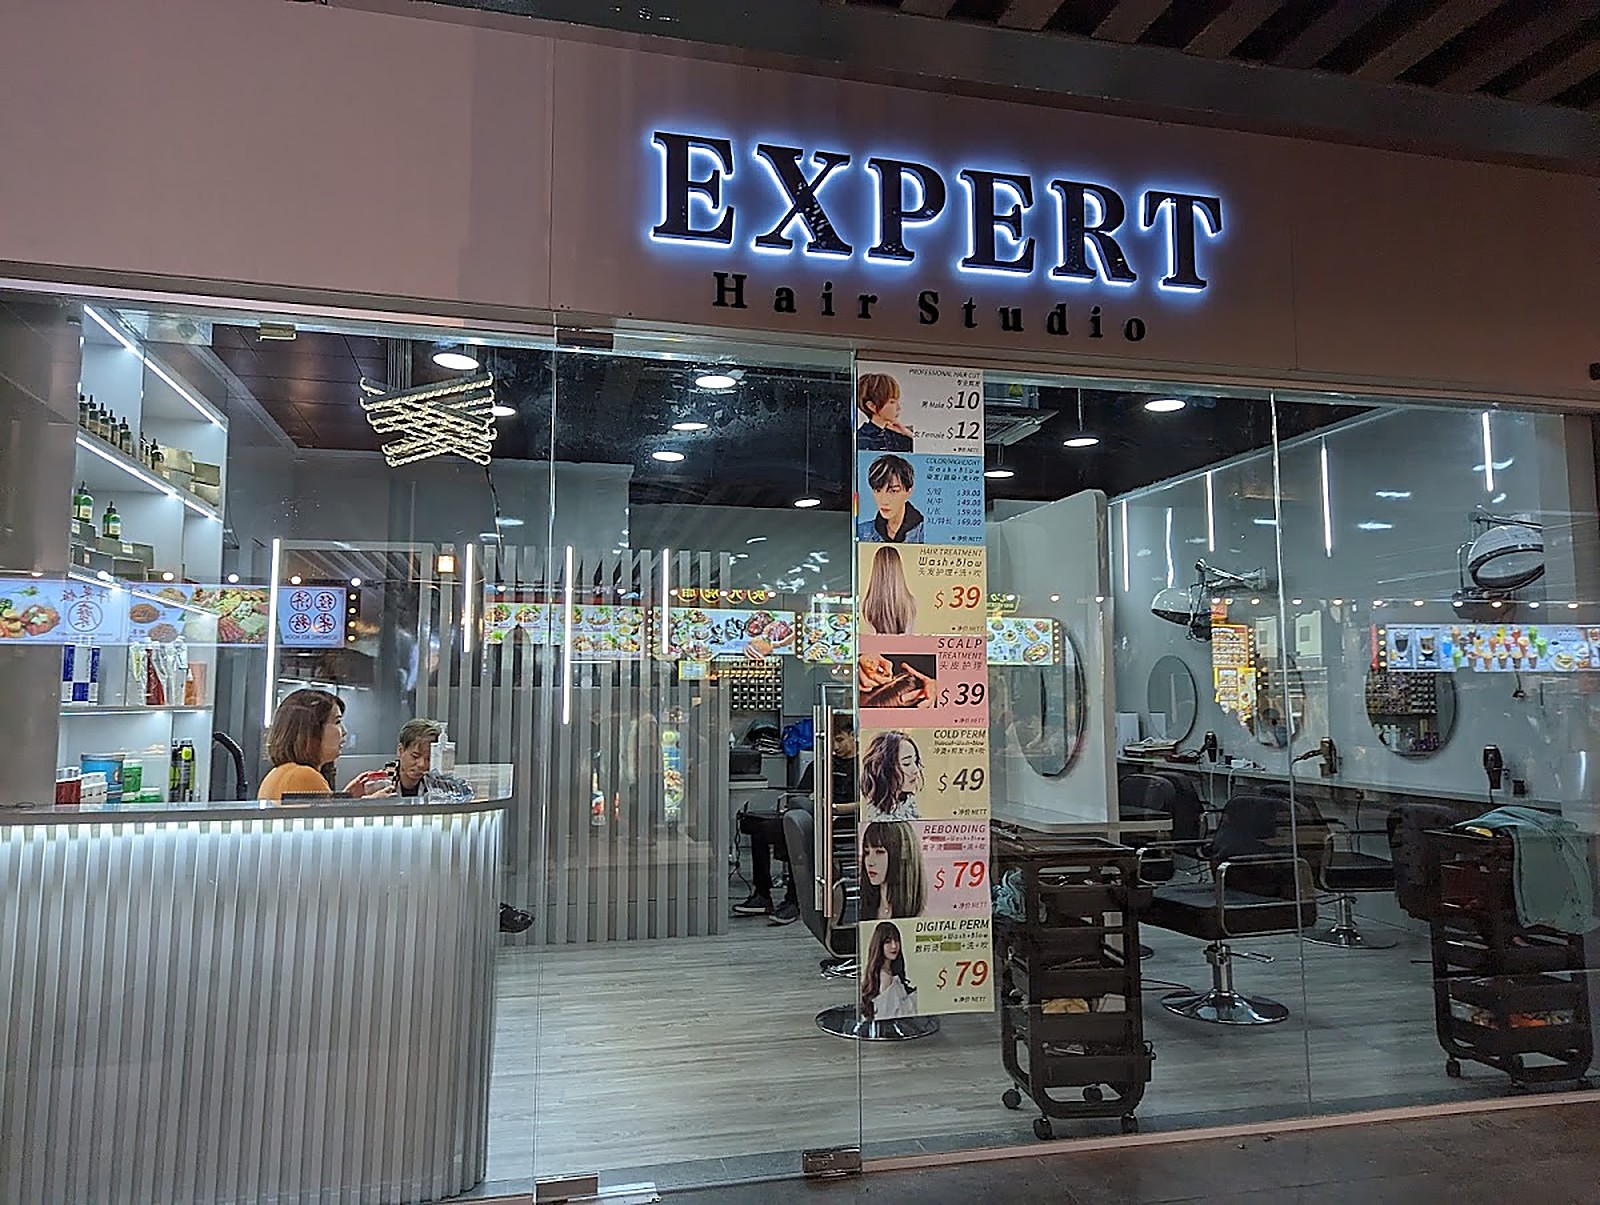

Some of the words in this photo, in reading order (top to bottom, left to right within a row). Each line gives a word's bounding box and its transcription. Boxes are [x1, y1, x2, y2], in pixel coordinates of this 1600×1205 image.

[650, 130, 1222, 291] EXPERT
[712, 271, 878, 320] Hair
[918, 290, 1147, 342] Studio
[921, 431, 945, 439] Female
[920, 548, 938, 556] HAIR
[939, 549, 983, 557] TREATMENT
[937, 637, 983, 649] SCALP
[938, 652, 983, 660] TREATMENT
[933, 730, 959, 739] COLD
[960, 729, 986, 739] PERM
[923, 824, 986, 834] REBONDING
[915, 920, 957, 933] DIGITAL
[959, 919, 990, 930] PERM
